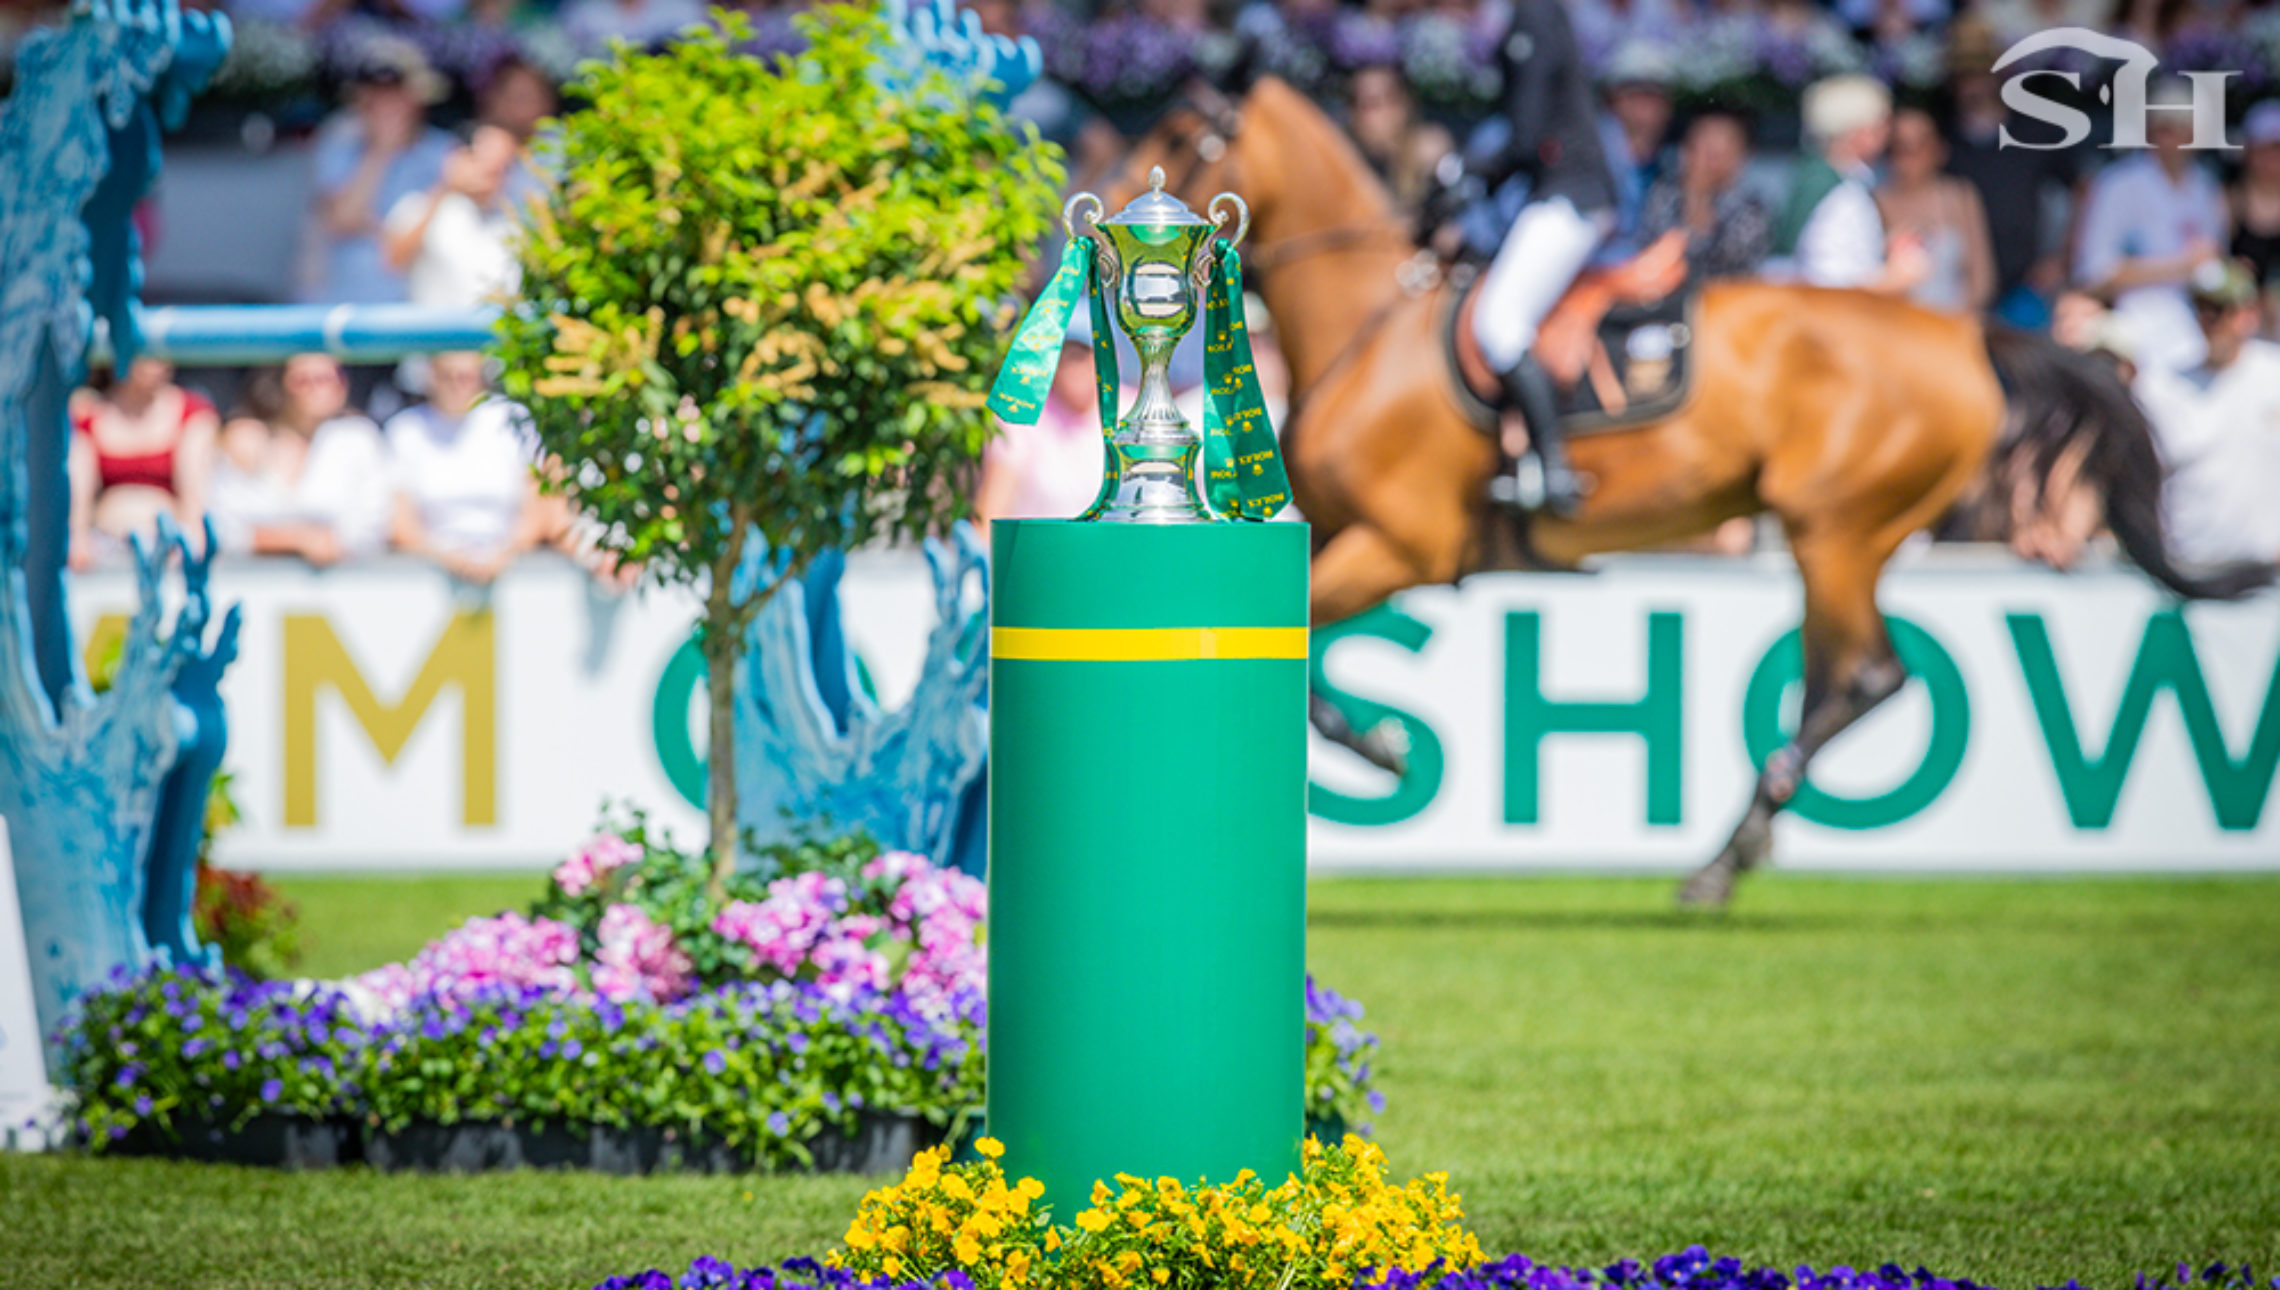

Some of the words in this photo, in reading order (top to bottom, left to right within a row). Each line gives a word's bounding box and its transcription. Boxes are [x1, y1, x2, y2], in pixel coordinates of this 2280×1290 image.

[1238, 449, 1274, 465] ROLEX
[1247, 492, 1284, 508] ROLEX
[1309, 606, 2280, 830] SHOW
